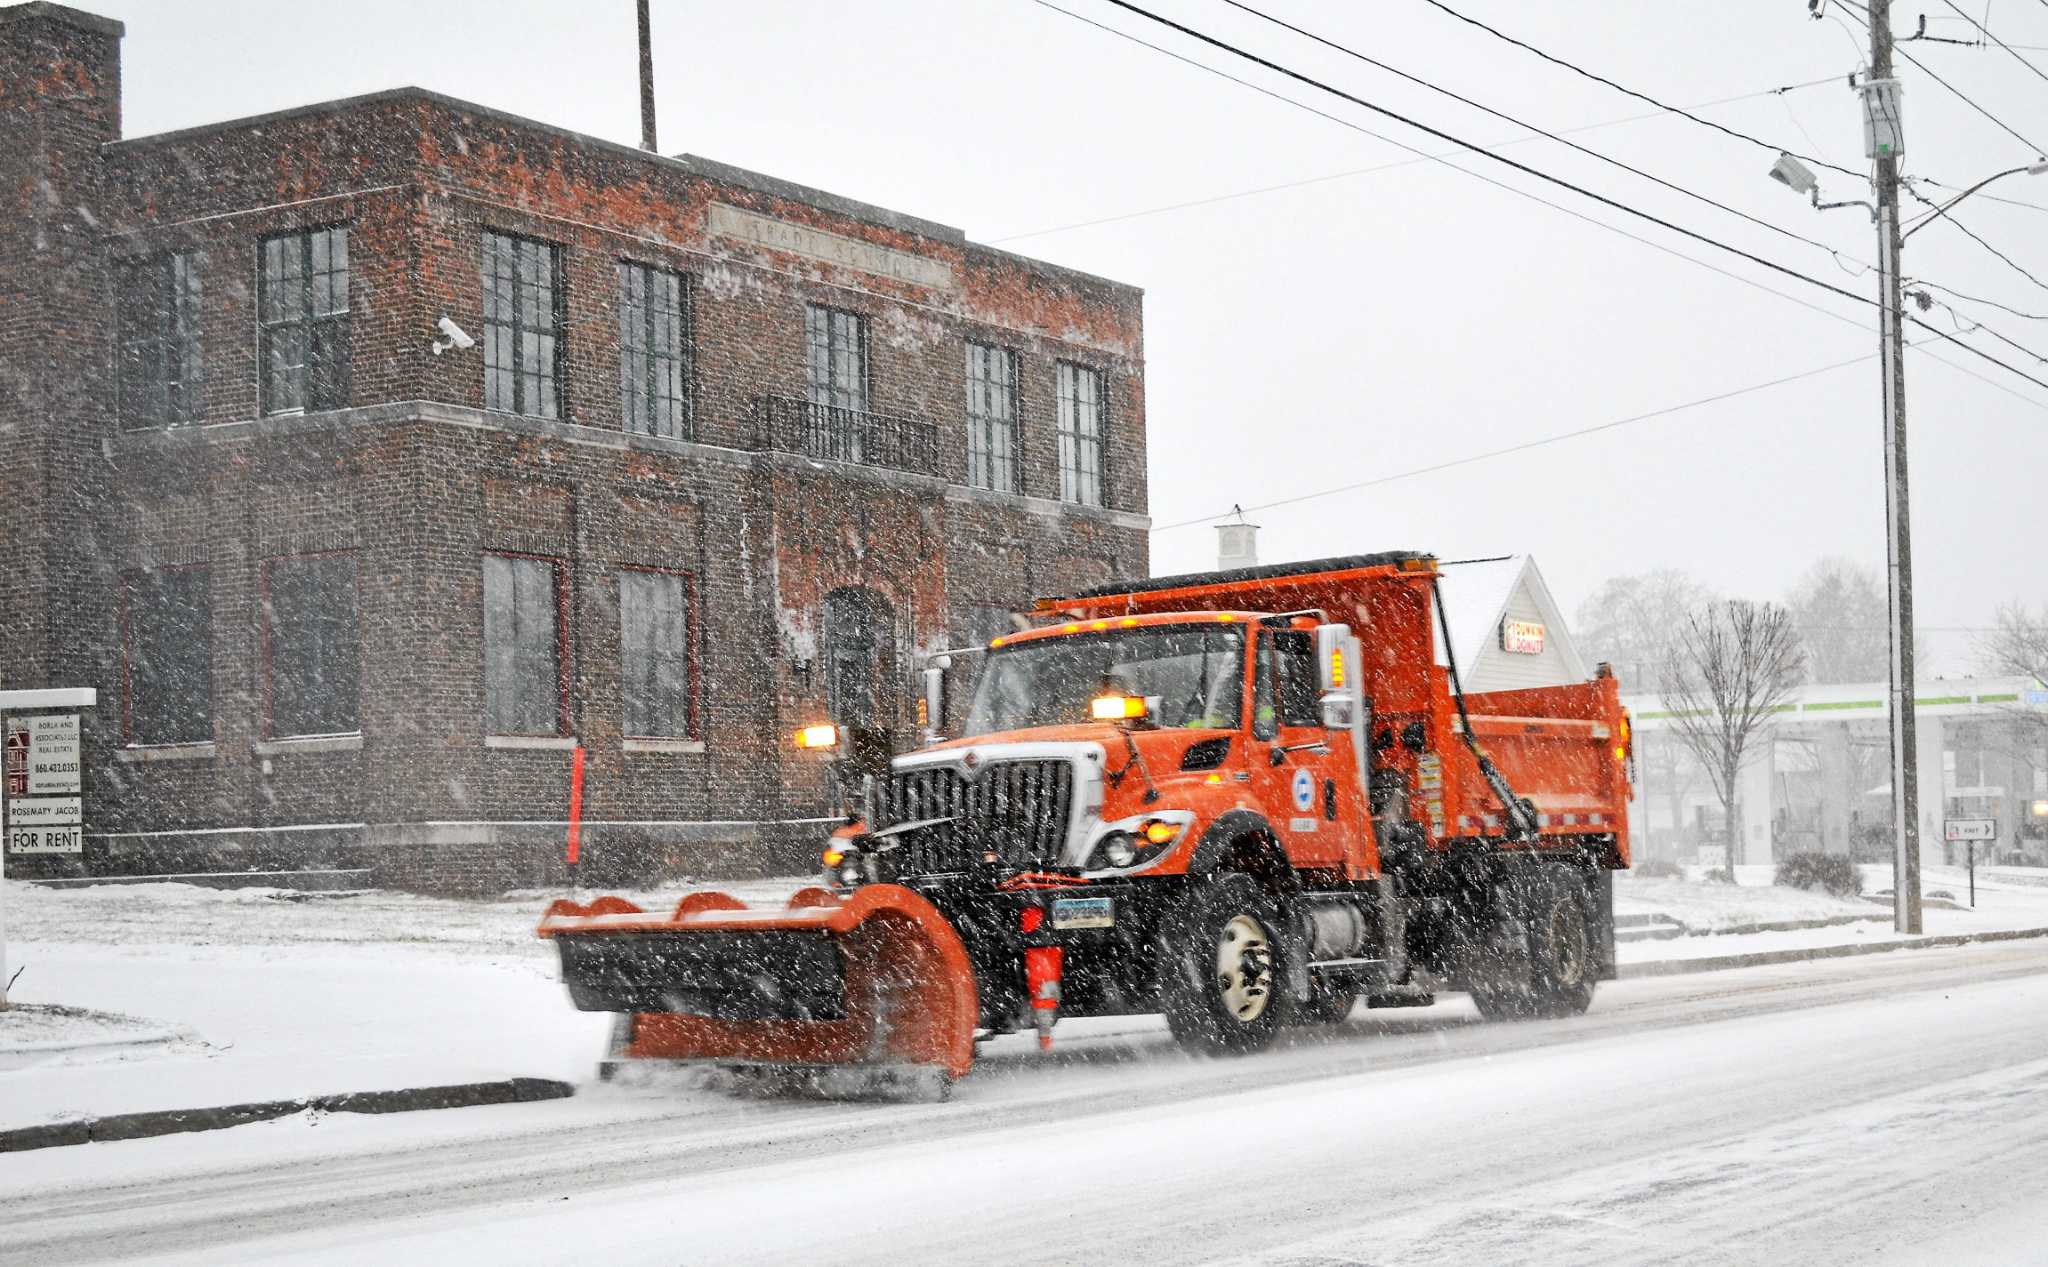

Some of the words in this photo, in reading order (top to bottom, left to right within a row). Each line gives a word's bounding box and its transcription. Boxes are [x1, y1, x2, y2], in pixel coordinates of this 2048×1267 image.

[752, 221, 816, 247] TRADE
[12, 807, 51, 816] ROSEMARY
[55, 806, 79, 815] JACOB
[13, 832, 39, 848] FOR
[46, 831, 79, 847] RENT
